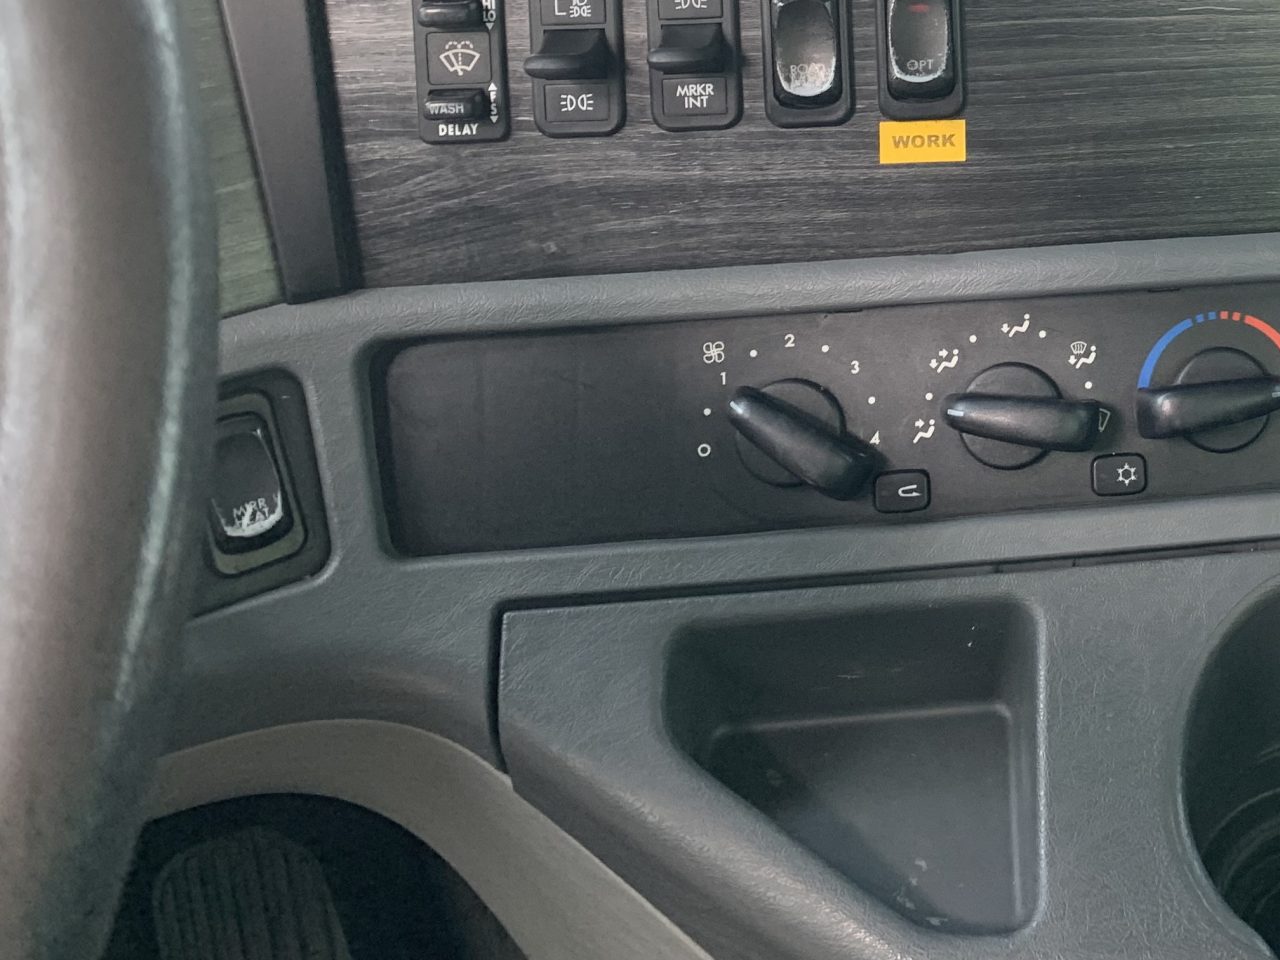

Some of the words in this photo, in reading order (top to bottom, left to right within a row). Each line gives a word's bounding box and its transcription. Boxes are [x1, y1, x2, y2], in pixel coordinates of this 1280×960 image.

[483, 11, 496, 22] LO
[676, 84, 714, 96] MRKR
[429, 102, 464, 114] WASH
[685, 96, 708, 109] INT
[438, 123, 479, 136] DELAY
[892, 133, 956, 149] WORK
[785, 334, 795, 347] 2
[851, 360, 860, 374] 3
[720, 372, 727, 385] 1
[869, 430, 880, 444] 4
